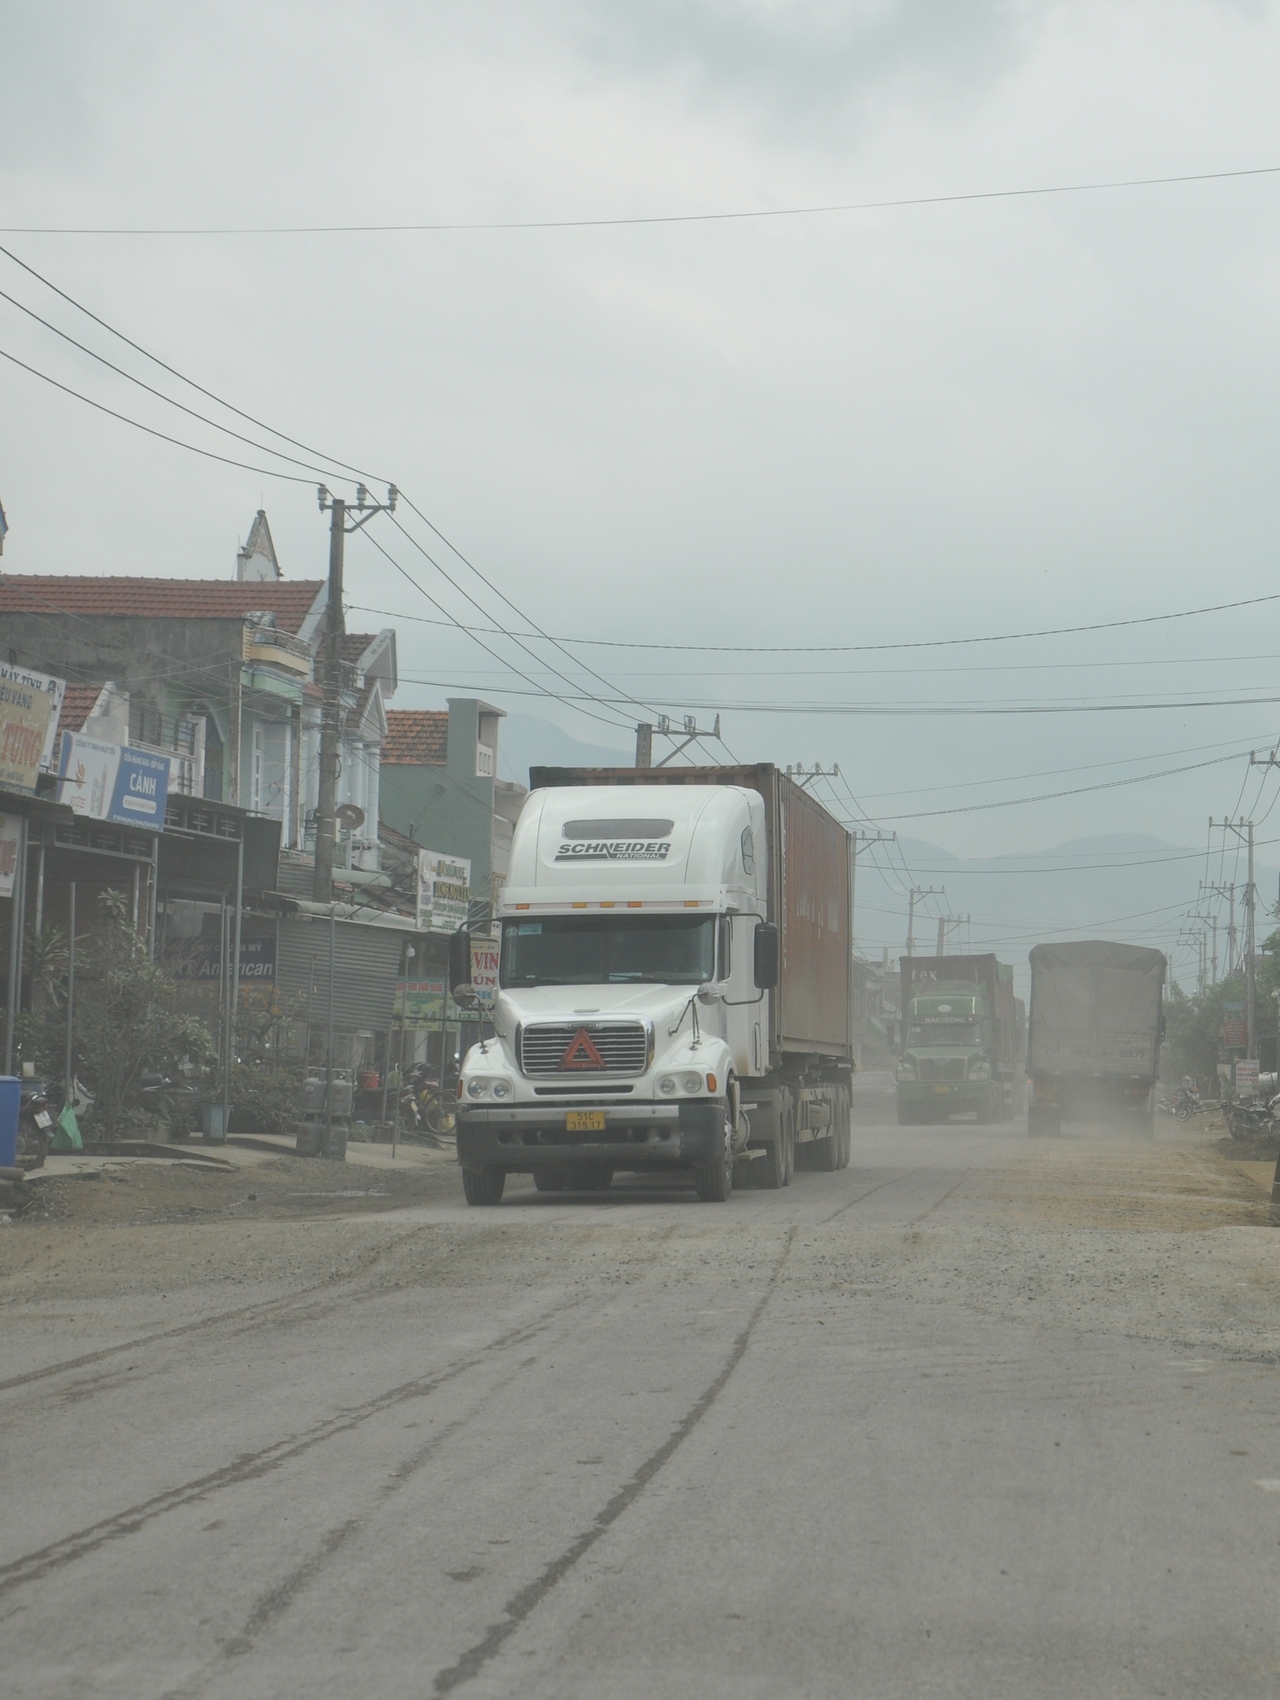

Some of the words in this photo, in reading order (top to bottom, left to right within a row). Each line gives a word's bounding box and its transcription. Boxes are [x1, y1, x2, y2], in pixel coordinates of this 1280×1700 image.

[129, 769, 157, 796] CẢNH
[557, 842, 672, 856] SCHNEIDER
[199, 959, 273, 976] Amican
[471, 974, 497, 986] ÚN
[577, 1112, 594, 1121] 51C
[571, 1120, 601, 1130] 319.17
